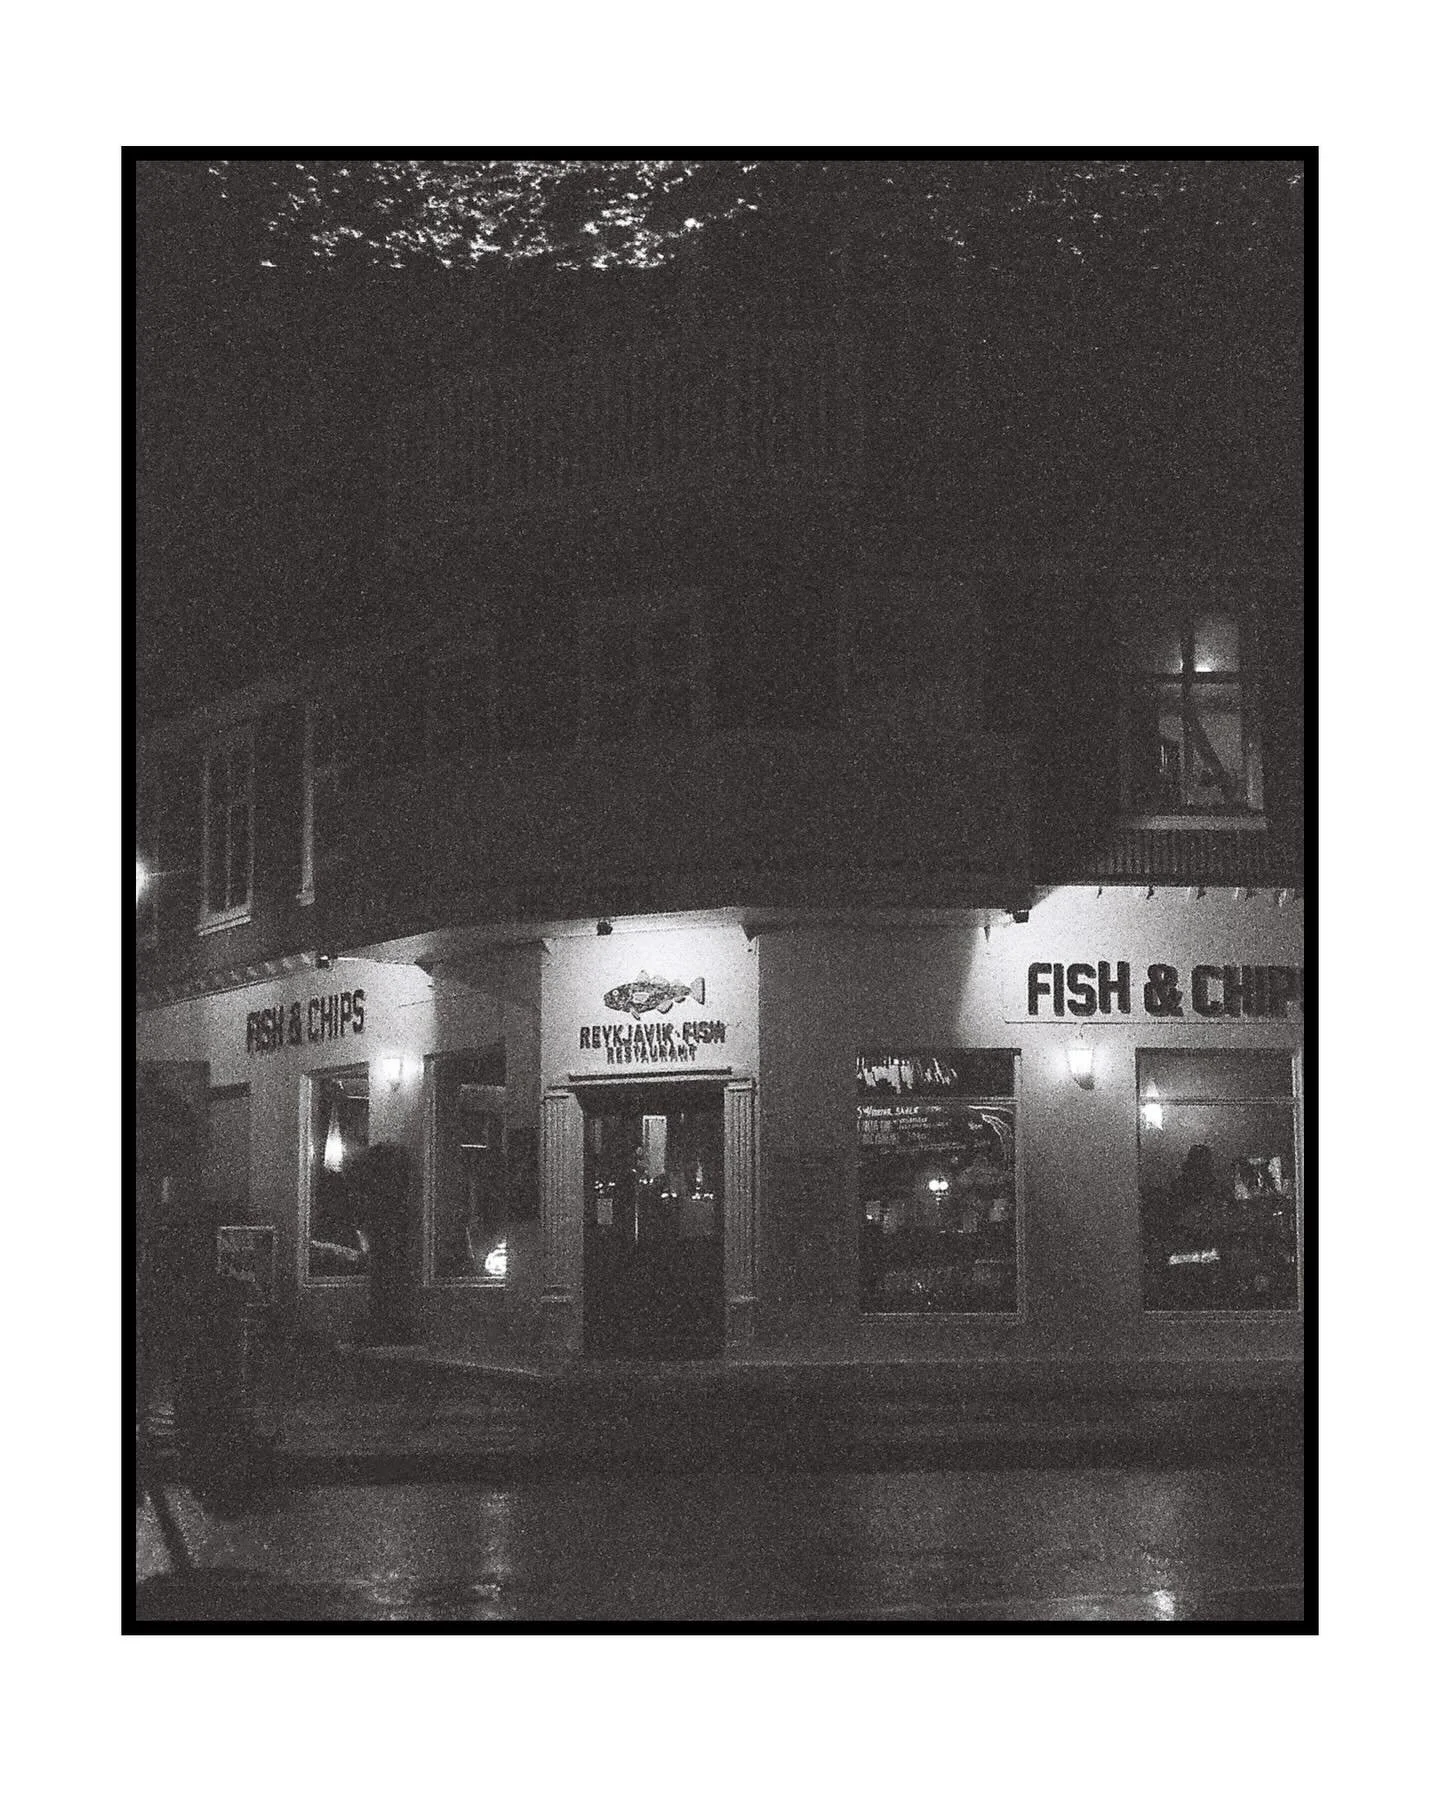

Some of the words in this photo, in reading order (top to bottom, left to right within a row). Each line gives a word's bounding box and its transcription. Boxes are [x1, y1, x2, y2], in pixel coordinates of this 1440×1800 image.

[1027, 961, 1131, 1017] FISH
[1144, 963, 1184, 1017] &
[1191, 965, 1304, 1018] CHIP
[246, 1005, 284, 1053] FISH
[288, 1002, 302, 1046] &
[308, 989, 366, 1042] CHIPS
[579, 1023, 675, 1050] REYKJAVIK
[606, 1045, 698, 1065] RESTAURANT
